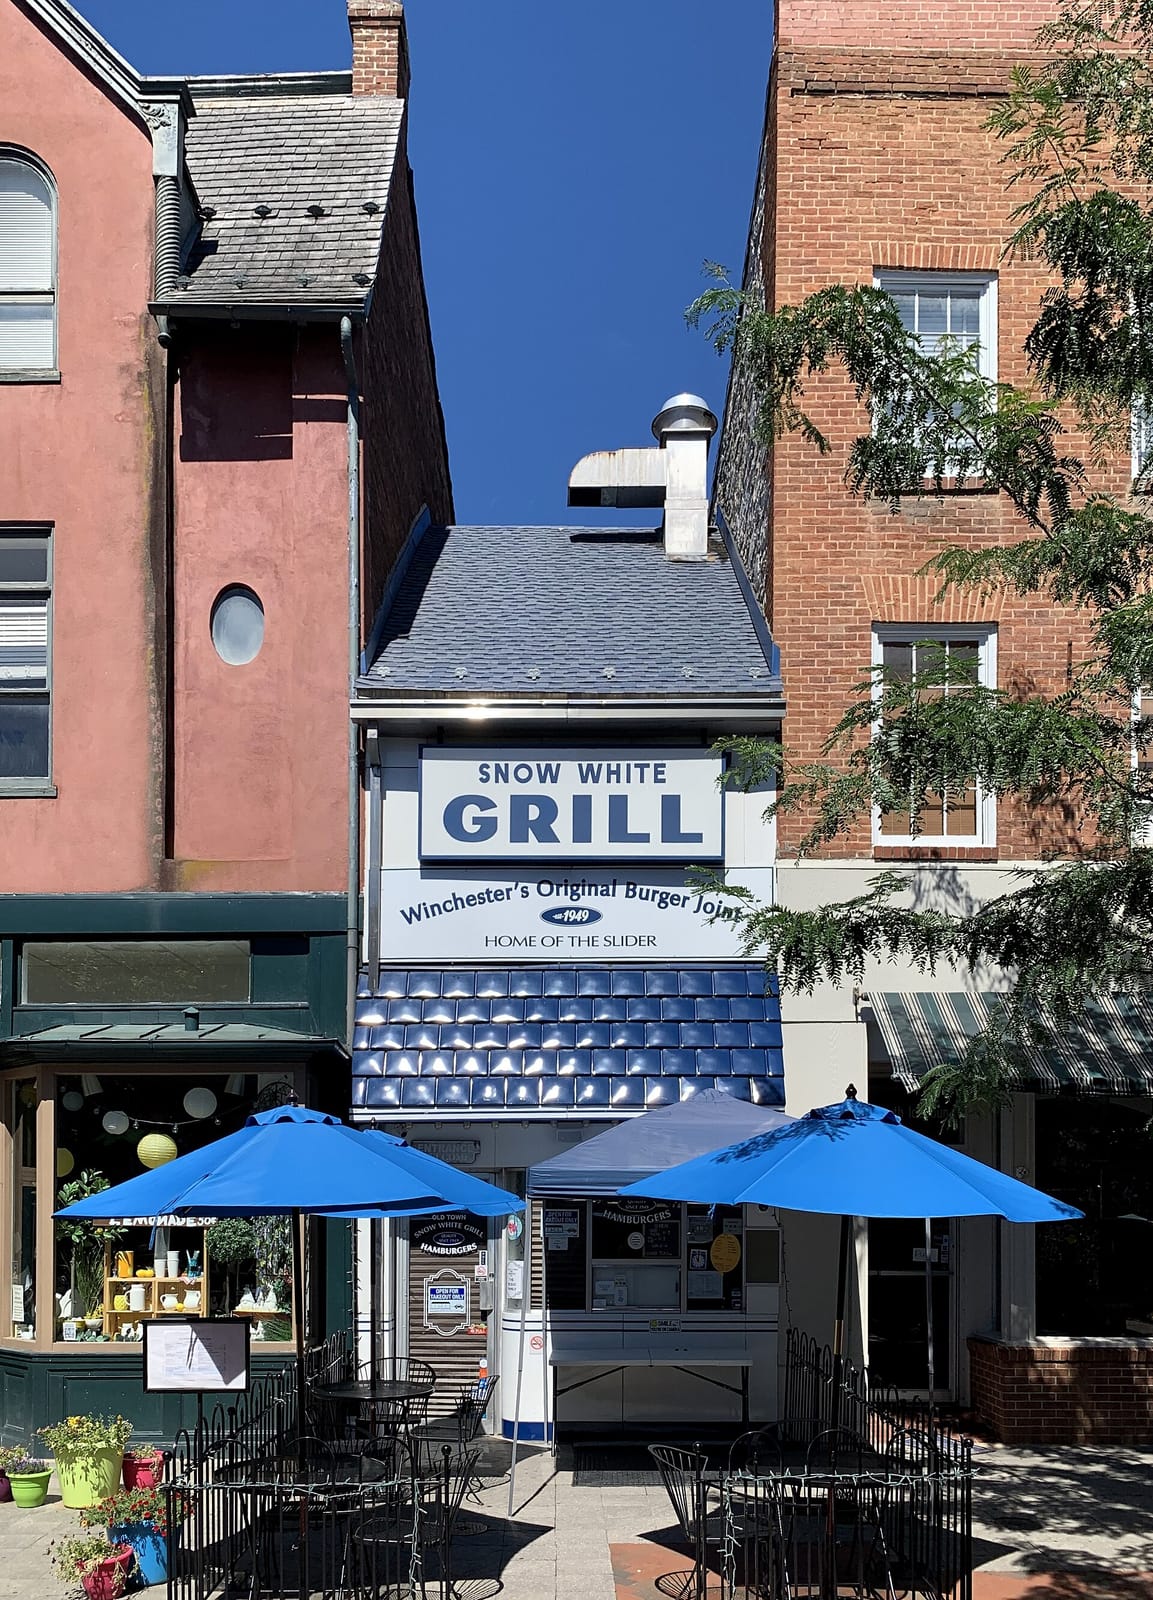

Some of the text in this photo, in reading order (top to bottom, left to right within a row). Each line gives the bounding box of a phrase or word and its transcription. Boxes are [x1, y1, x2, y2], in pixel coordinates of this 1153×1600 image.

[478, 762, 667, 784] SNOW WHITE
[442, 793, 704, 844] GRILL
[400, 880, 530, 925] Winchester's
[536, 879, 617, 900] Original
[624, 881, 690, 909] Burger
[563, 909, 590, 922] 1949
[485, 935, 658, 947] HOME OF THE SLIDER
[602, 1209, 672, 1225] HAMBURGERS
[413, 1221, 485, 1239] SNOW WHITE GRILL
[420, 1242, 478, 1255] HAMBURGERS
